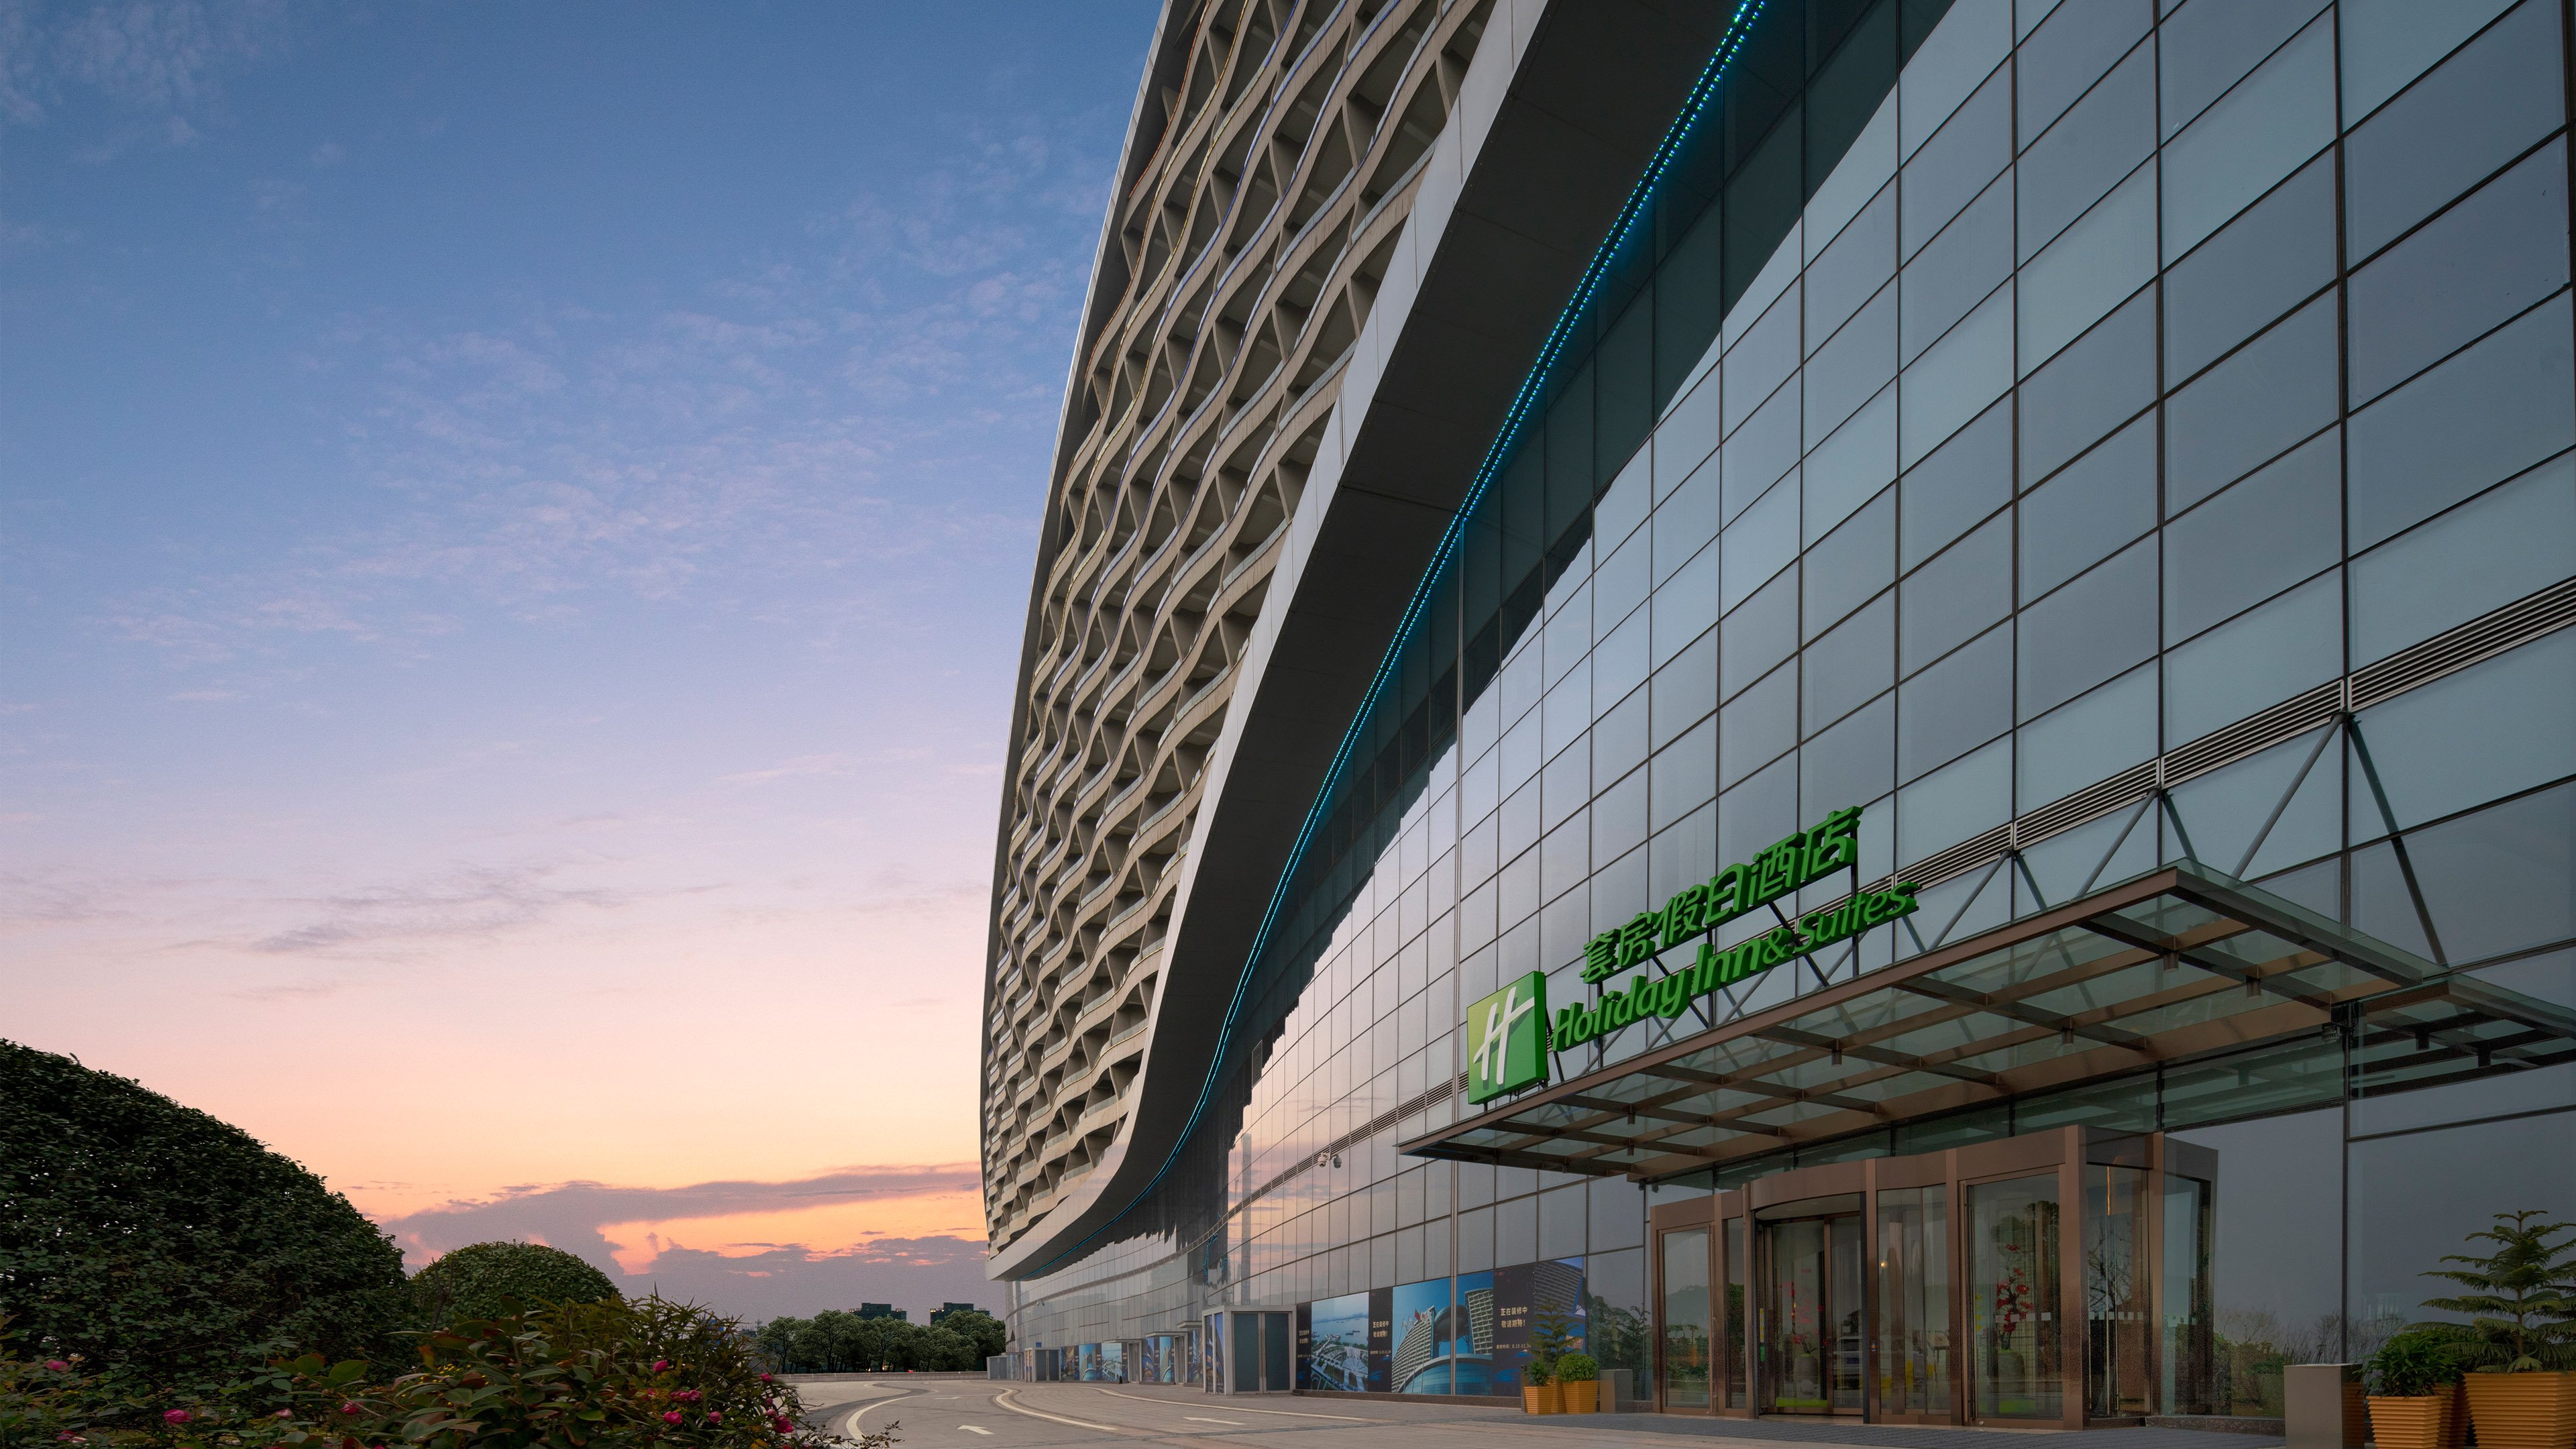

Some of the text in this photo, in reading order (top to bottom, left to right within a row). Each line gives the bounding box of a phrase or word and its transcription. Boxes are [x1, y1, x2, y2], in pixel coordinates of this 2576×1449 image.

[1579, 805, 1864, 984] 套房假日酒店
[1550, 968, 1695, 1052] Holiday
[1691, 936, 1768, 996] Inn
[1762, 928, 1793, 965] &
[1500, 1305, 1527, 1316] 正在装修中
